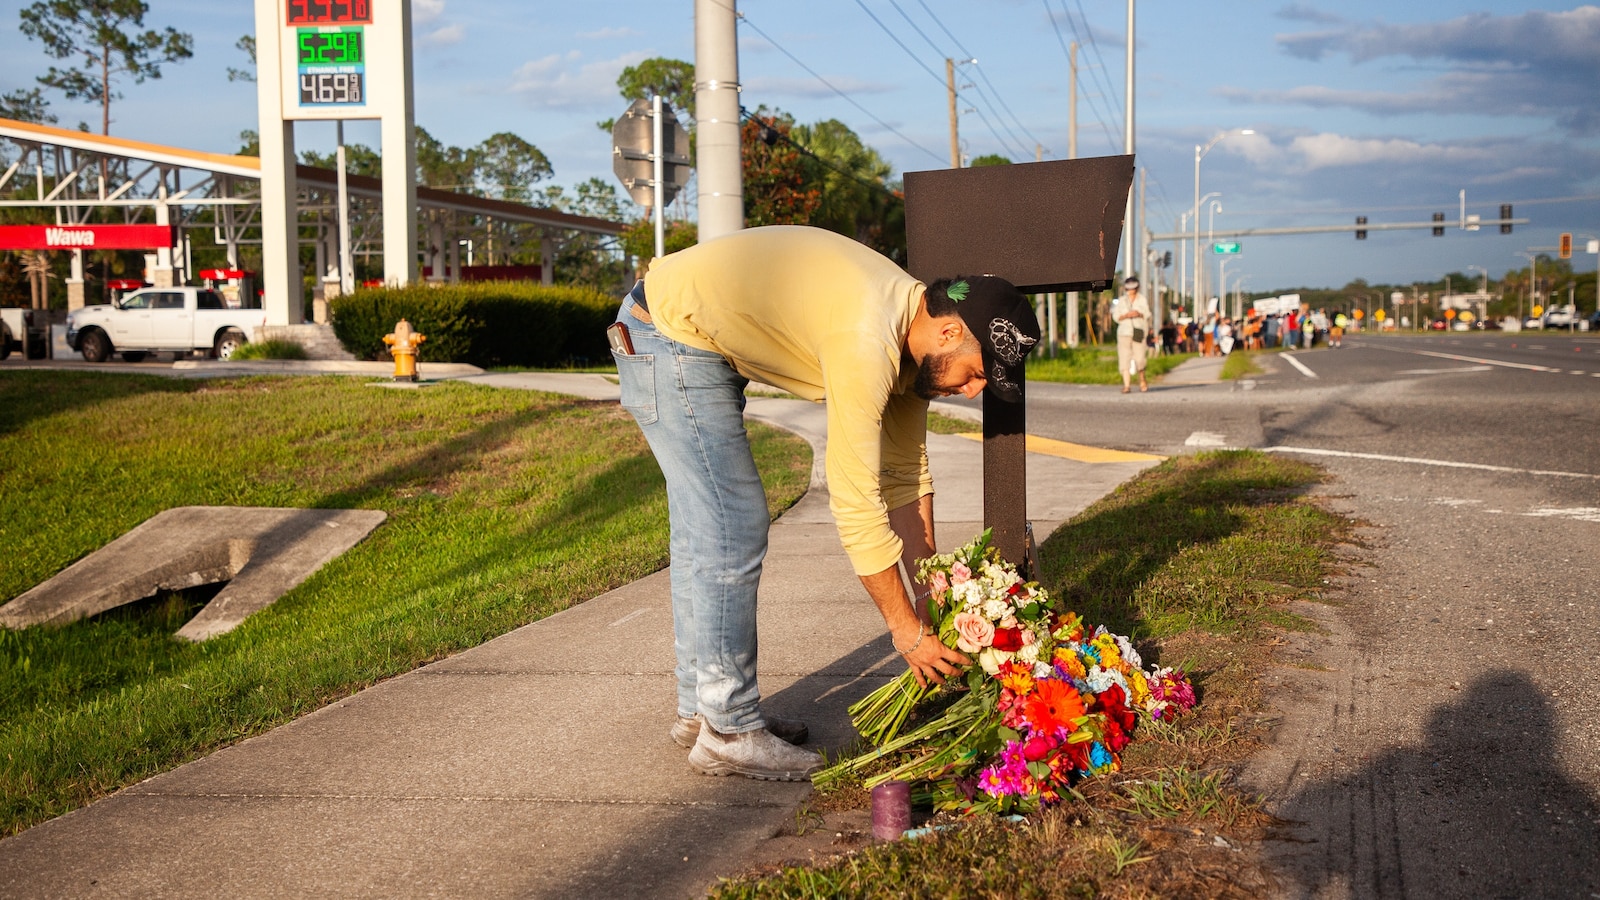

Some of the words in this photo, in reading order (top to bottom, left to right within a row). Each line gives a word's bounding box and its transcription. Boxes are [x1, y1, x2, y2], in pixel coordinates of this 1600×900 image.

[300, 33, 348, 63] 5.29
[301, 74, 349, 103] 4.69
[45, 227, 95, 246] Wawa
